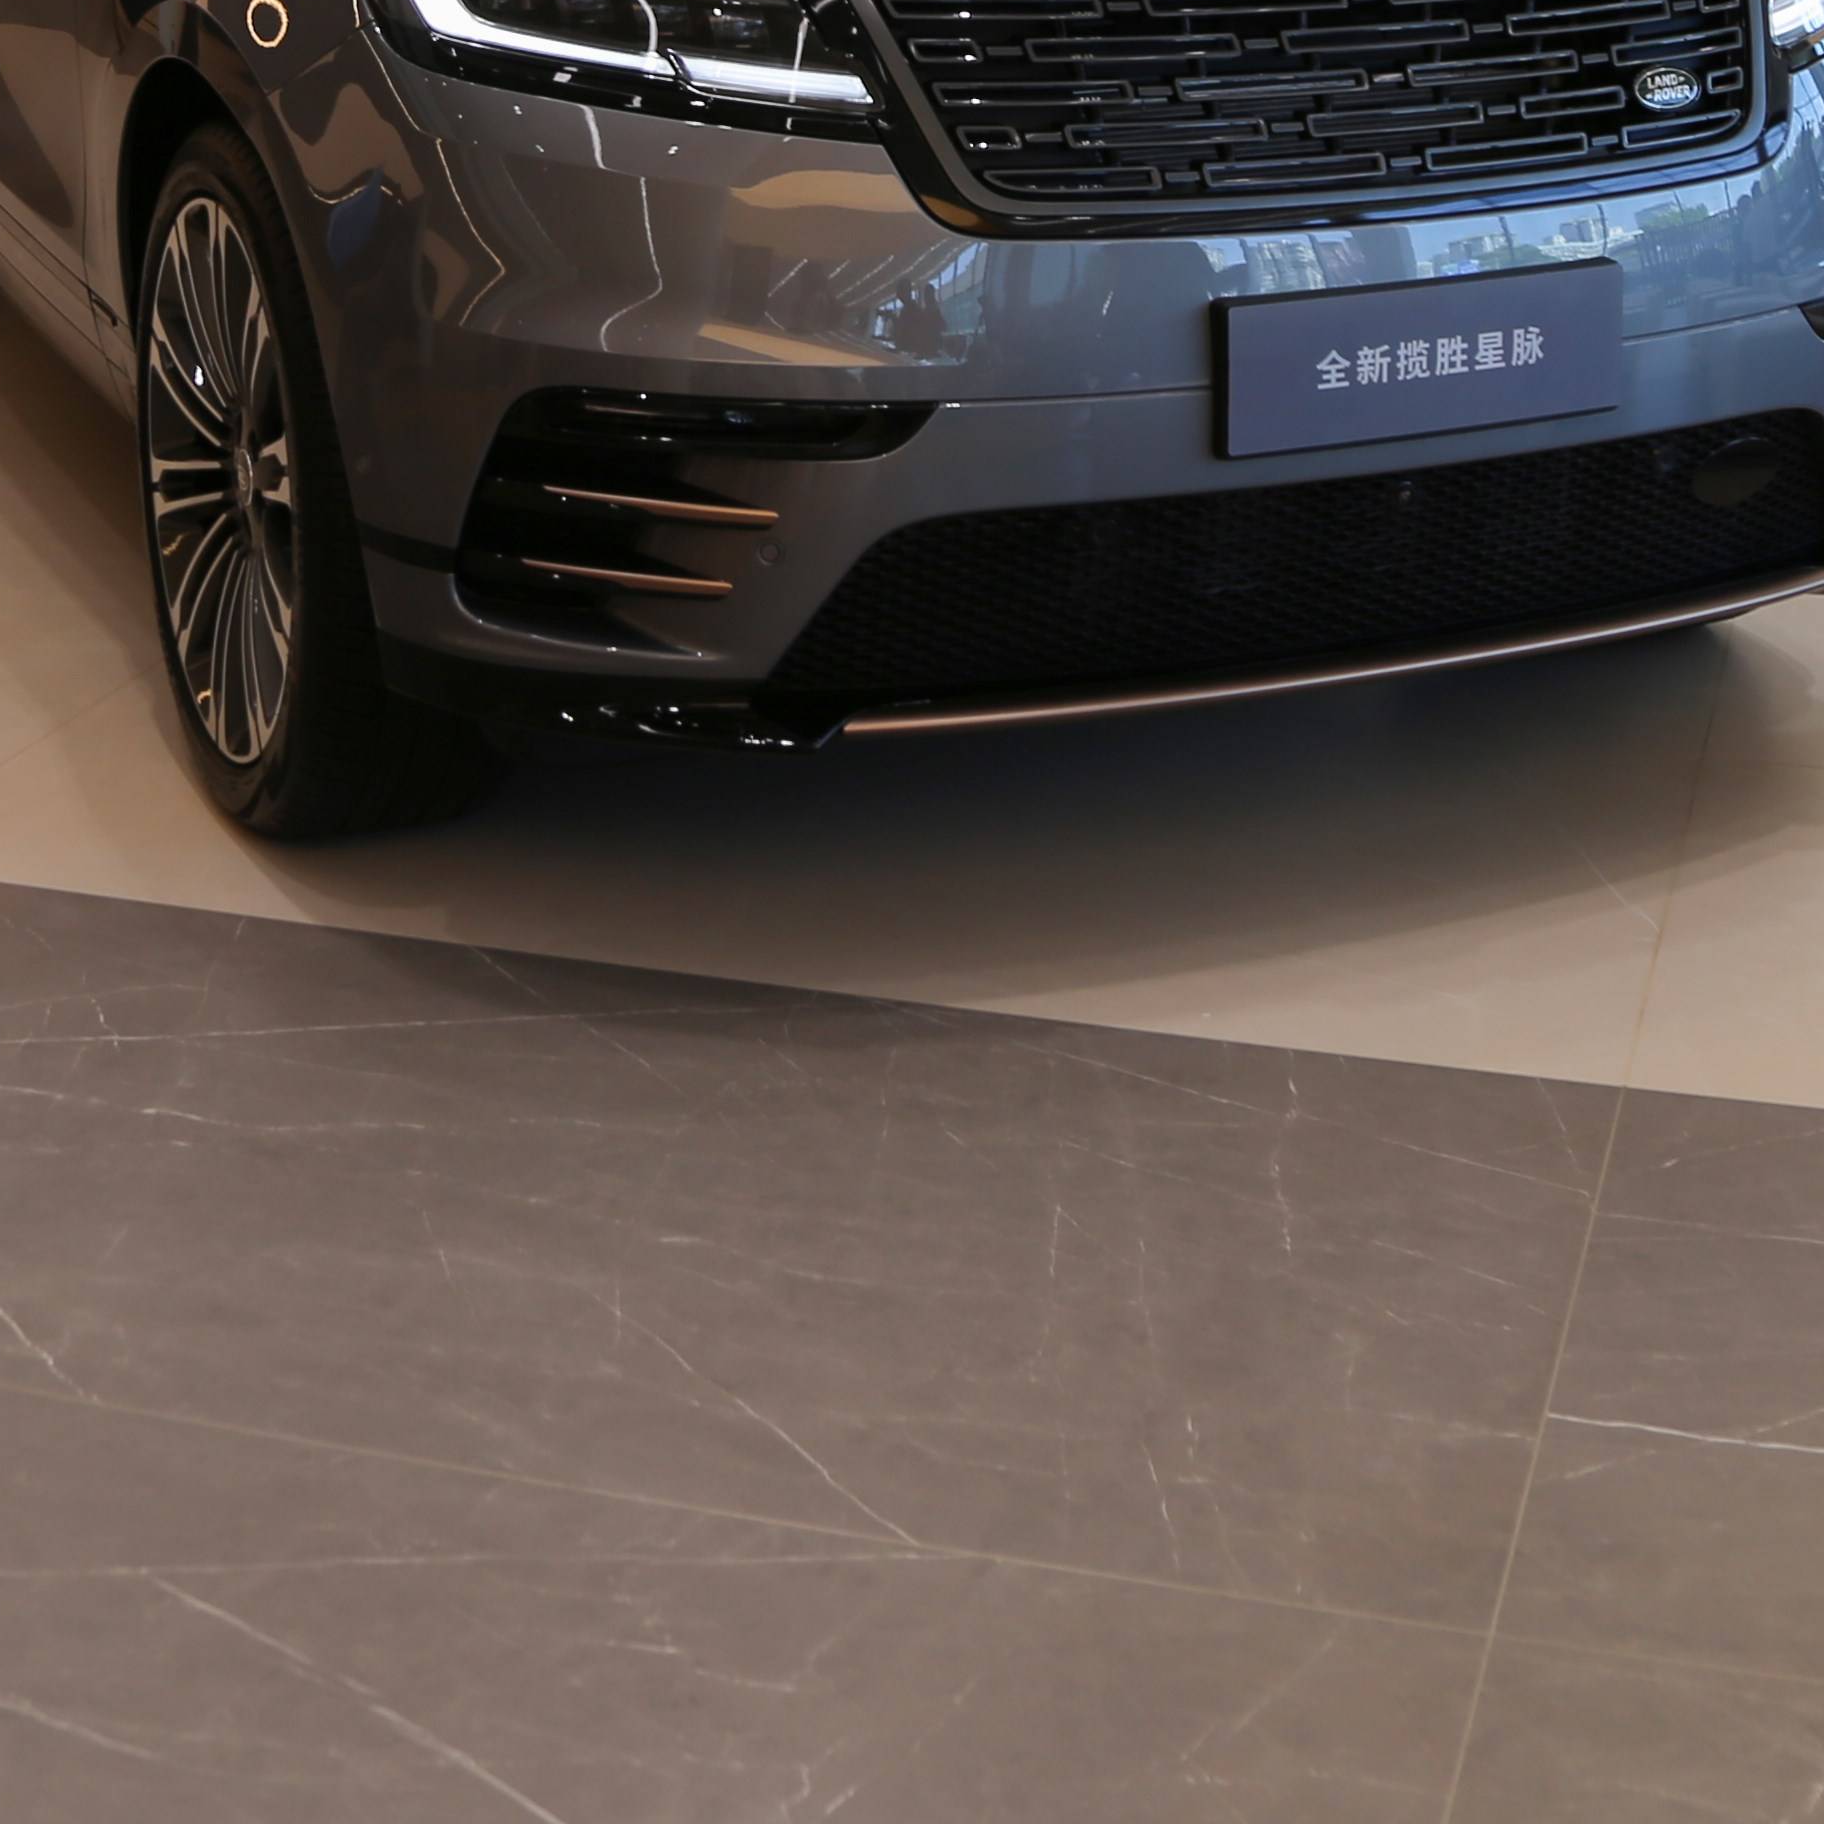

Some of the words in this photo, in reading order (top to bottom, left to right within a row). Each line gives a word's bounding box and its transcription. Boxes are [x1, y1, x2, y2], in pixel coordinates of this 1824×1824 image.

[1647, 74, 1678, 89] LAND
[1654, 84, 1692, 102] ROVER
[1315, 326, 1545, 391] 全新揽胜星脉
